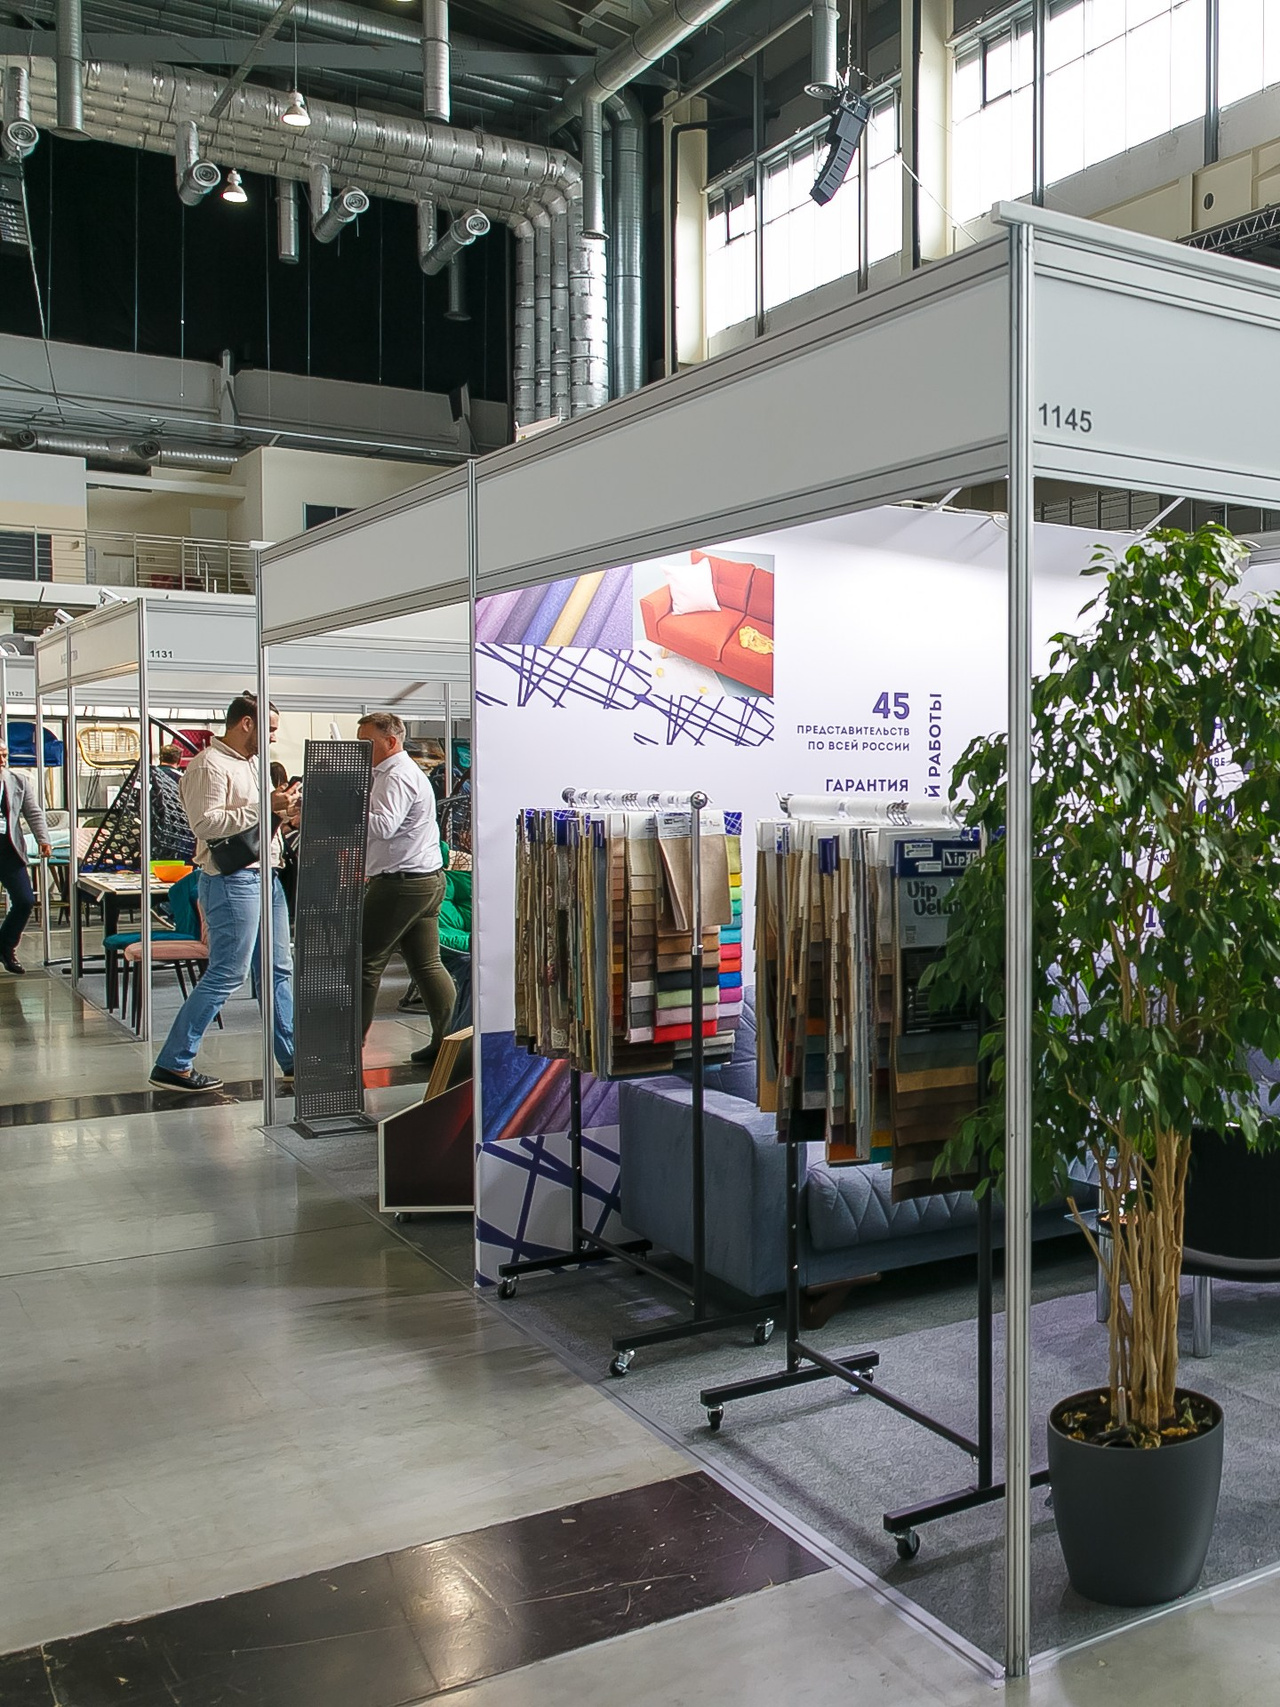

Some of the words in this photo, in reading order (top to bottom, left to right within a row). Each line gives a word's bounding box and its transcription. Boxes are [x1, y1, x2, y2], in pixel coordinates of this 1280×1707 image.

[1038, 402, 1092, 433] 1145
[149, 650, 173, 659] 1131
[872, 691, 910, 720] 45
[796, 725, 910, 736] ПРЕДСТАВИТЕЛЬСТВ
[928, 693, 942, 777] РАБОТЫ
[808, 741, 825, 750] ПО
[828, 739, 858, 751] ВСЕЙ
[862, 741, 910, 751] РОССИИ
[825, 778, 909, 792] ГАРАНТИЯ
